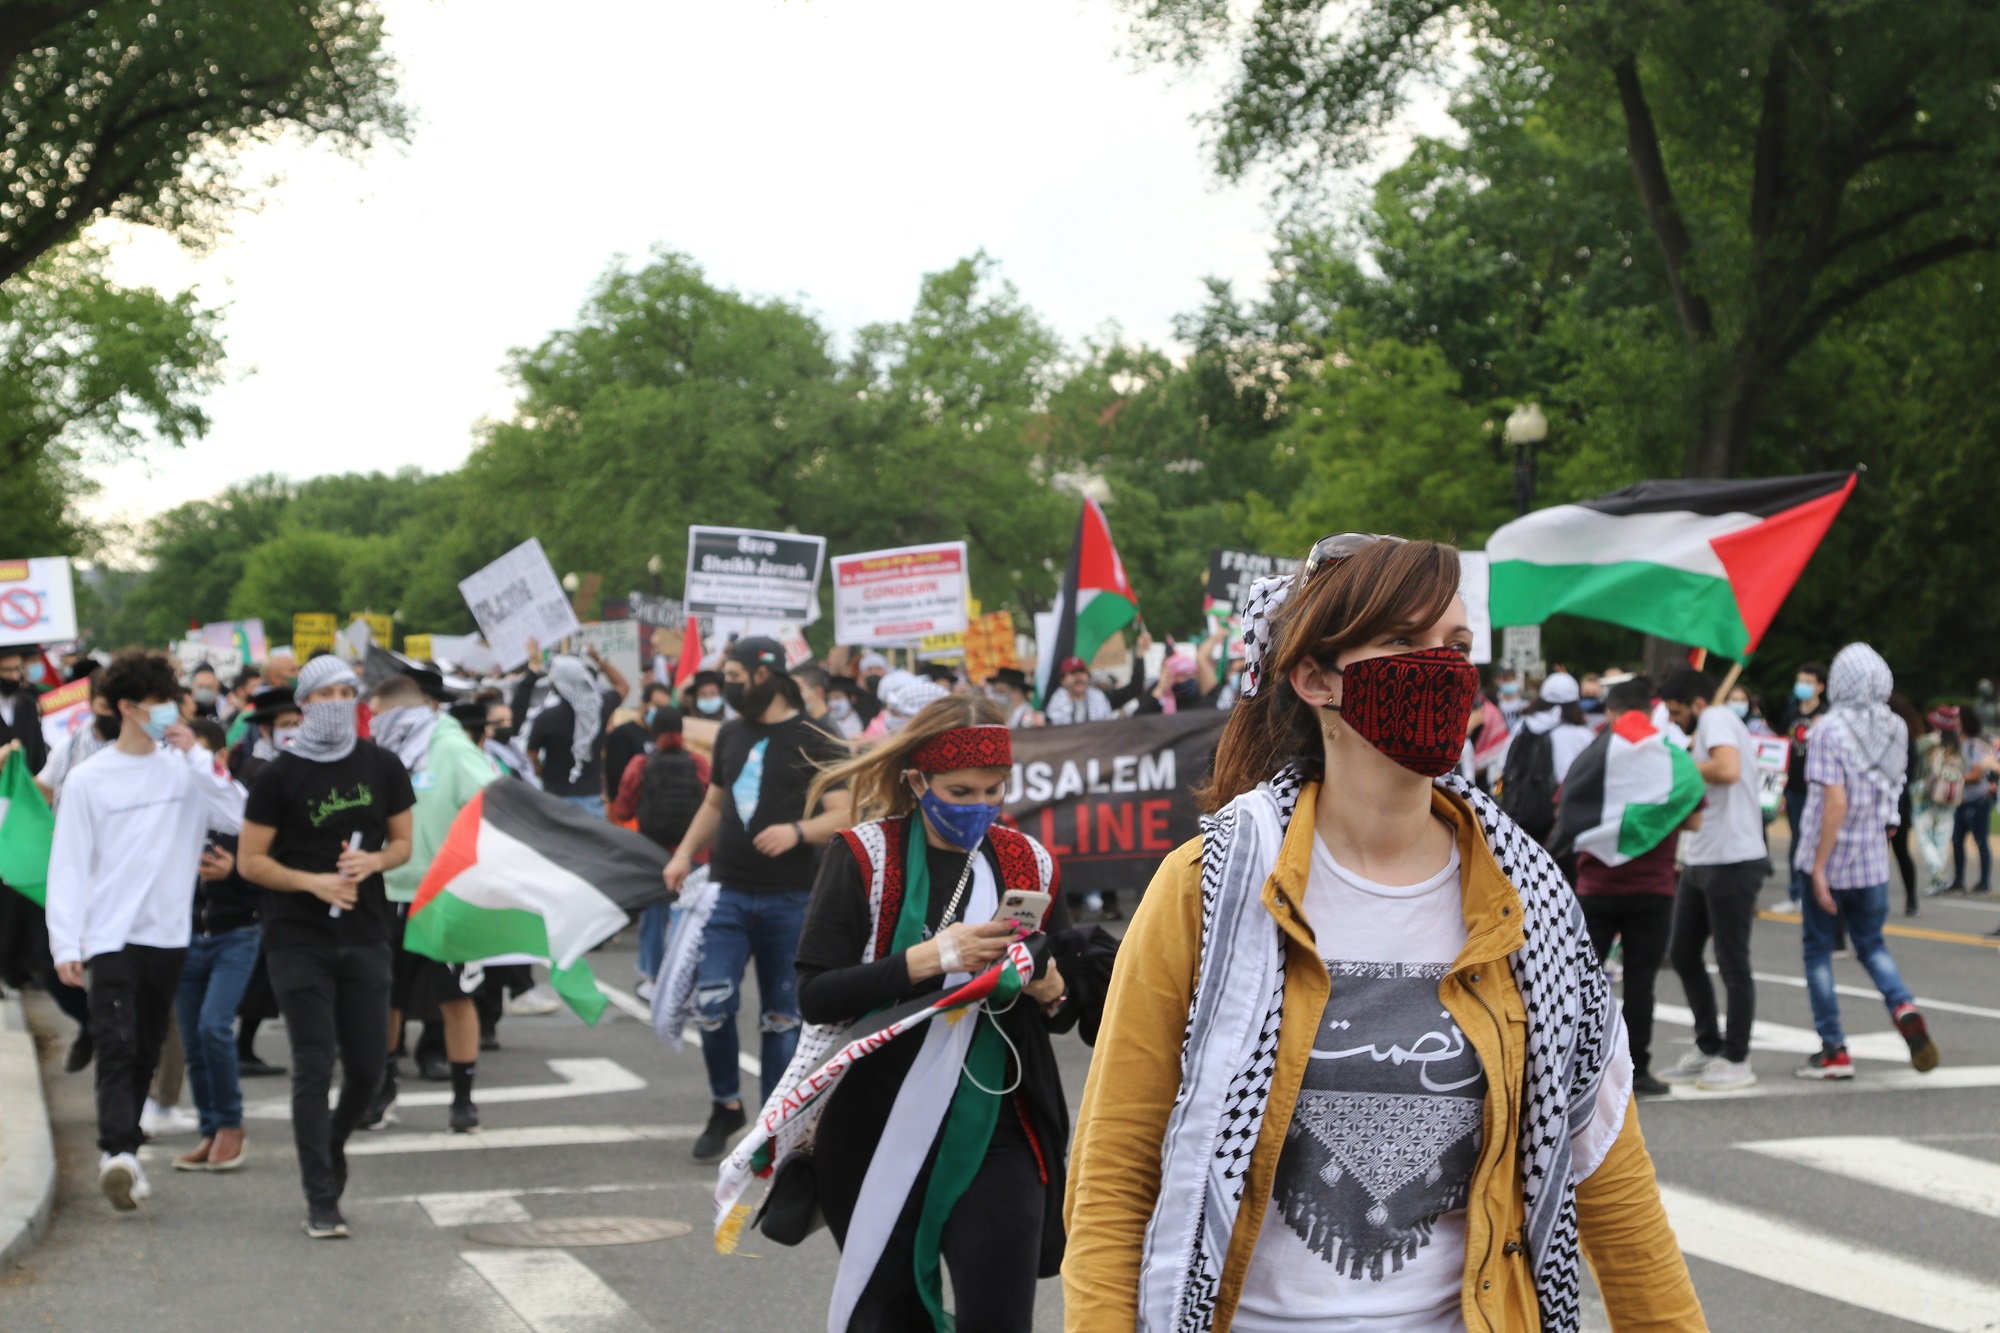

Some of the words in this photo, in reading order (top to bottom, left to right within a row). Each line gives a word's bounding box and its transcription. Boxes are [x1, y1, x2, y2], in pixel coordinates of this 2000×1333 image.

[738, 536, 777, 556] Save
[702, 554, 756, 575] Sheikh
[757, 558, 808, 579] Jarrah
[1221, 550, 1272, 573] FROM
[863, 581, 938, 600] CONDEMN
[1004, 749, 1176, 804] USALEM
[1041, 799, 1173, 855] LINE
